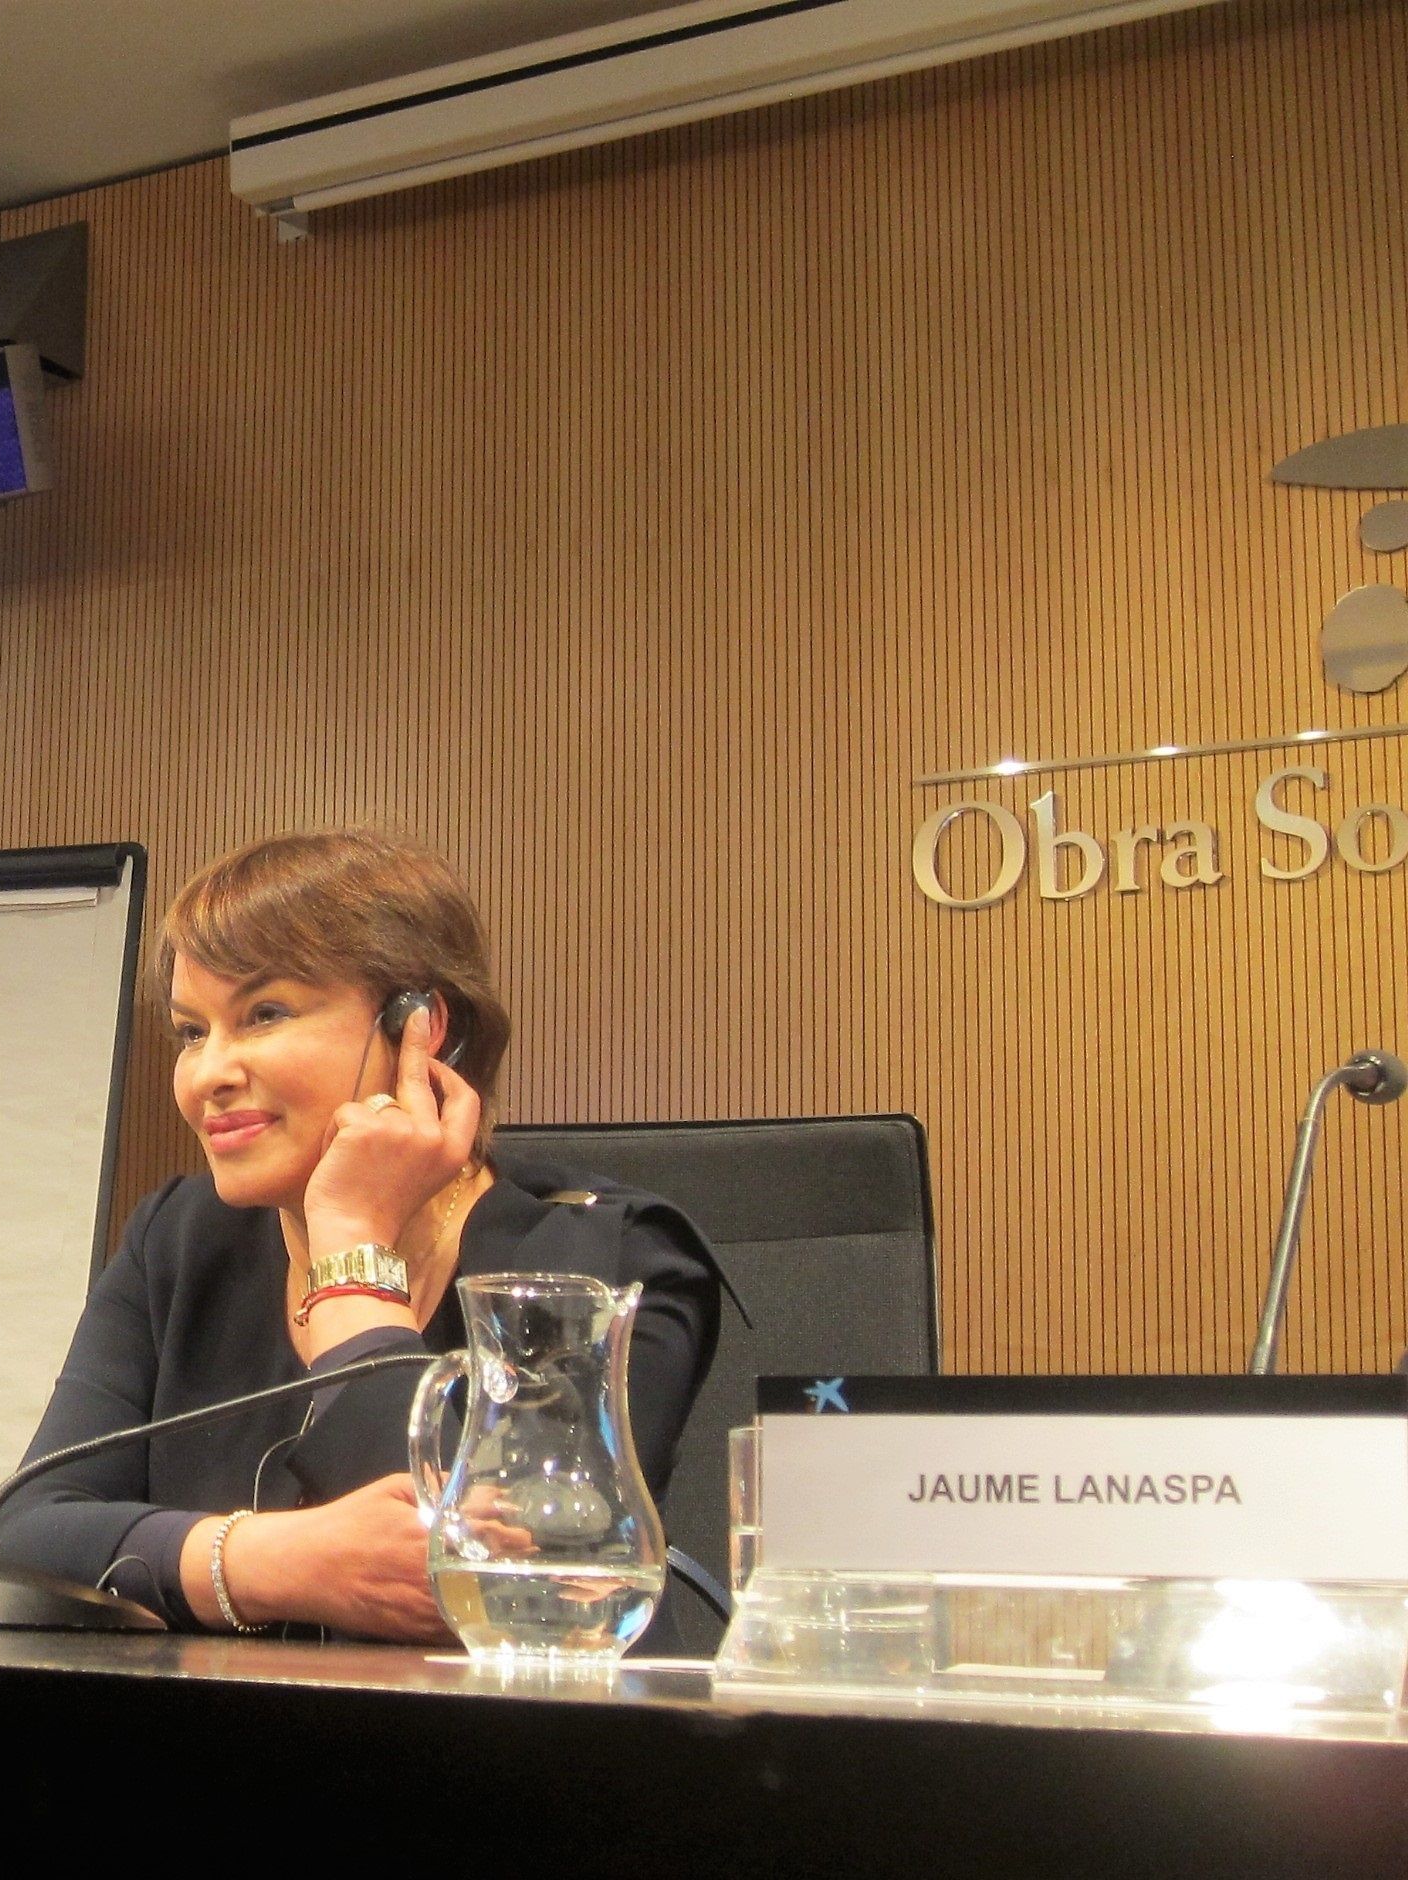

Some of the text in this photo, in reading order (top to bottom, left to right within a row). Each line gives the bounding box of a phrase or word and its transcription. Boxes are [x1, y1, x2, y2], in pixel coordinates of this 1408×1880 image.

[912, 789, 1226, 911] Obra
[907, 1472, 1243, 1506] JAUME LANASPA
